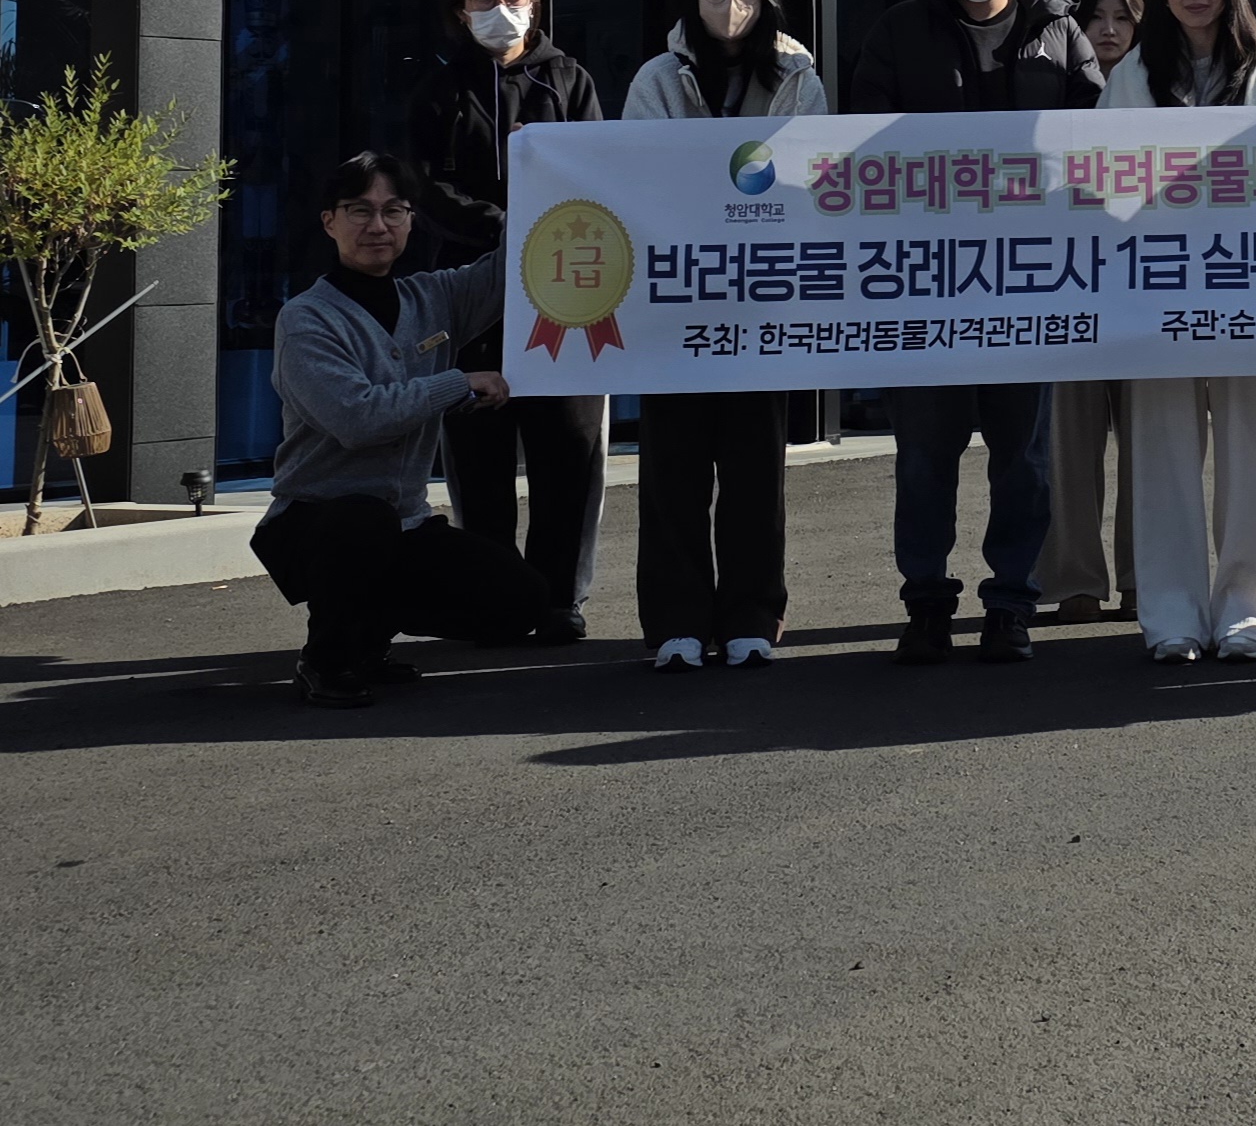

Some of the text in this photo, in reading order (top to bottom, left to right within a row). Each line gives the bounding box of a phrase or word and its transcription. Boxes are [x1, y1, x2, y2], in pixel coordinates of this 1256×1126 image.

[811, 152, 1044, 212] 청암대학교
[724, 203, 785, 217] 청암대학교
[551, 246, 606, 289] 1급
[647, 241, 846, 304] 반려동물
[857, 235, 1105, 300] 장례지도사
[1116, 233, 1191, 291] 1급
[682, 311, 1099, 358] 주최: 한국반려동물자격관리협회
